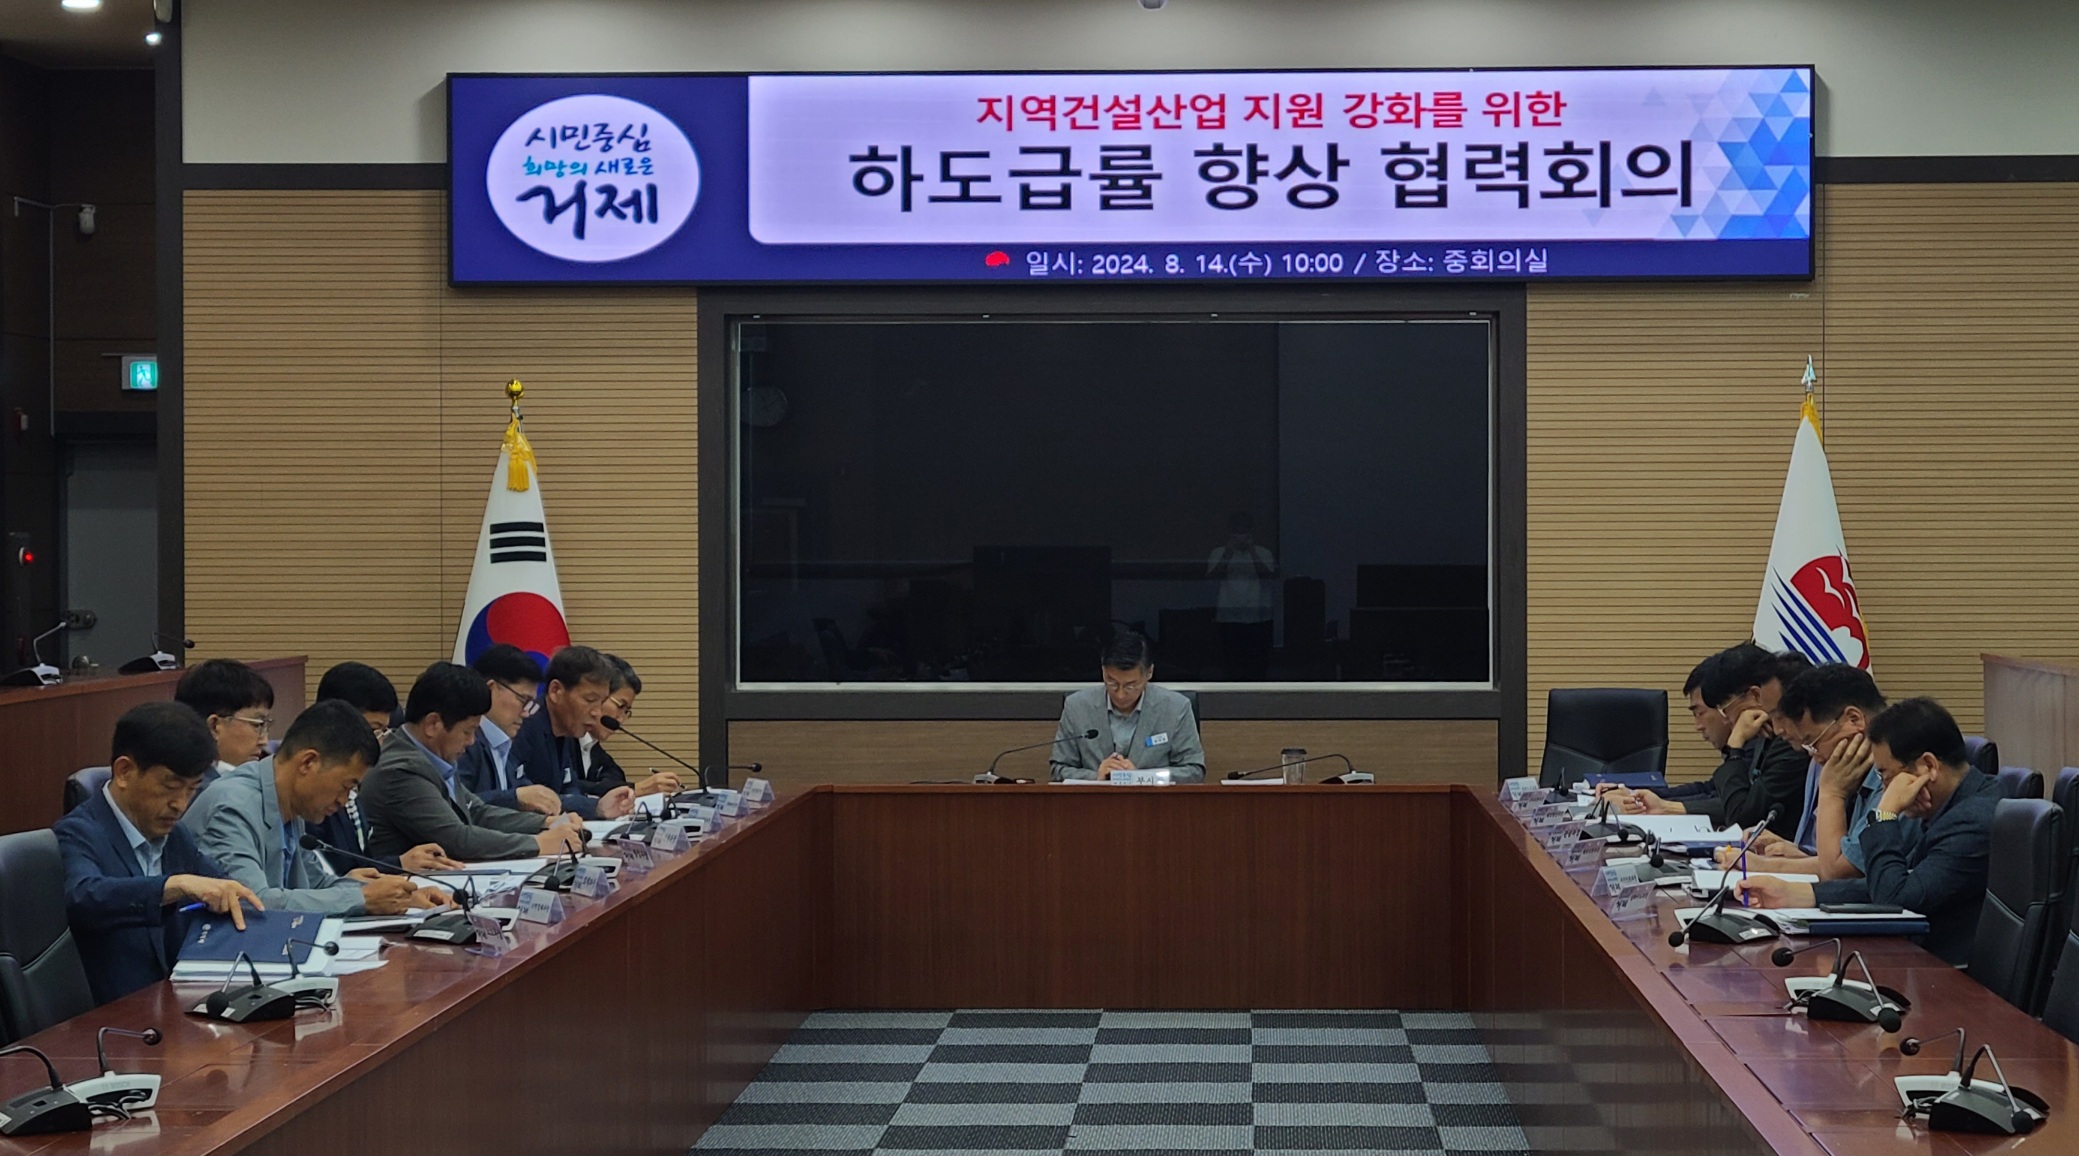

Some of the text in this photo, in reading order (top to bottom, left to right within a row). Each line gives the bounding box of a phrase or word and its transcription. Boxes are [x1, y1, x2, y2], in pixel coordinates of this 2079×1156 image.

[976, 90, 1566, 131] 지역건설산업 지원 강화를 위한
[525, 122, 652, 153] 시민중심
[522, 155, 654, 178] 희망의 새로운
[848, 140, 1693, 213] 하도급률 향상 협력회의
[515, 179, 658, 240] 거제
[1025, 250, 1084, 276] 일시:
[1091, 253, 1154, 276] 2024.
[1164, 254, 1186, 275] 8.
[1195, 251, 1273, 277] 14.(수)
[1281, 253, 1344, 274] 10:00
[1375, 249, 1435, 274] 장소:
[1442, 249, 1548, 274] 중회의실
